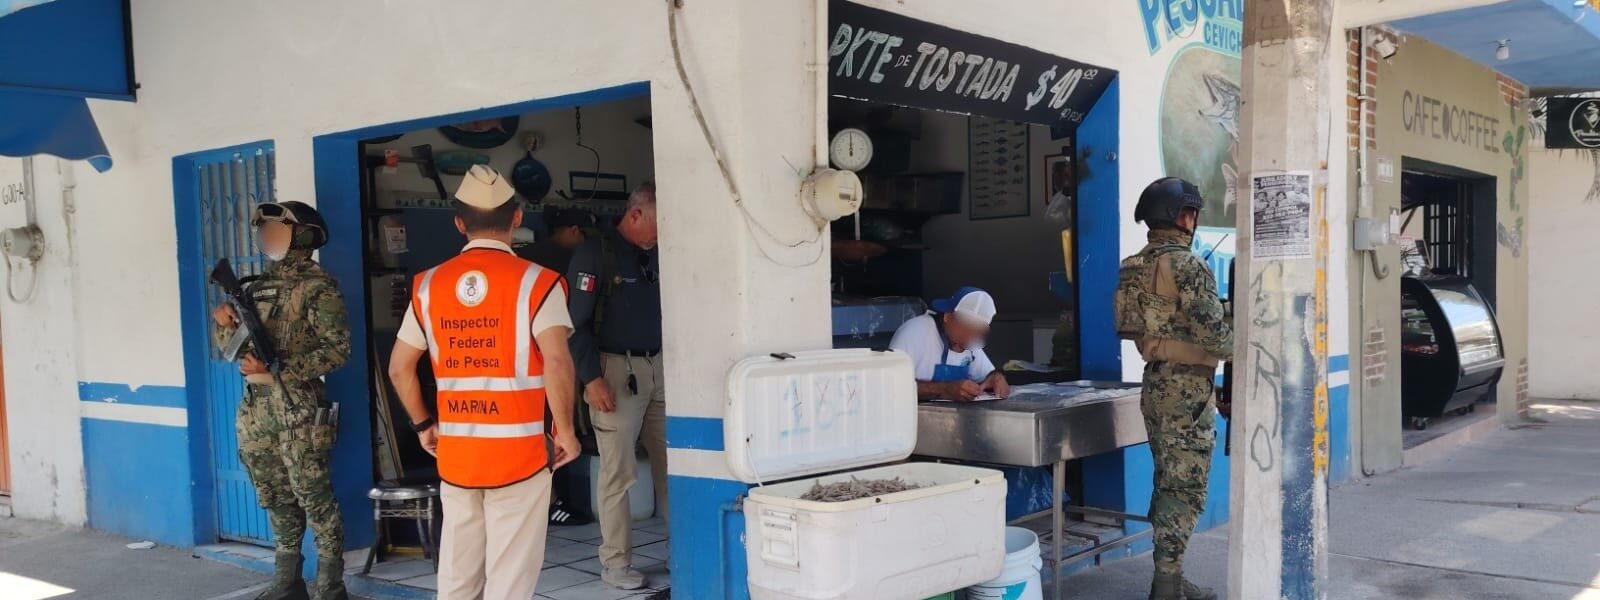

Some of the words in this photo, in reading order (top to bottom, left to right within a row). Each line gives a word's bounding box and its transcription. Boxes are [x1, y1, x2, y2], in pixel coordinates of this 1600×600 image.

[828, 23, 904, 83] PKTE
[894, 54, 912, 68] DE
[904, 42, 1020, 103] TOSTADA
[1450, 104, 1499, 153] COFFEE
[440, 316, 500, 331] Inspector
[449, 336, 496, 349] Federal
[445, 356, 459, 368] de
[464, 356, 499, 368] Pesca
[447, 399, 500, 415] MARINA
